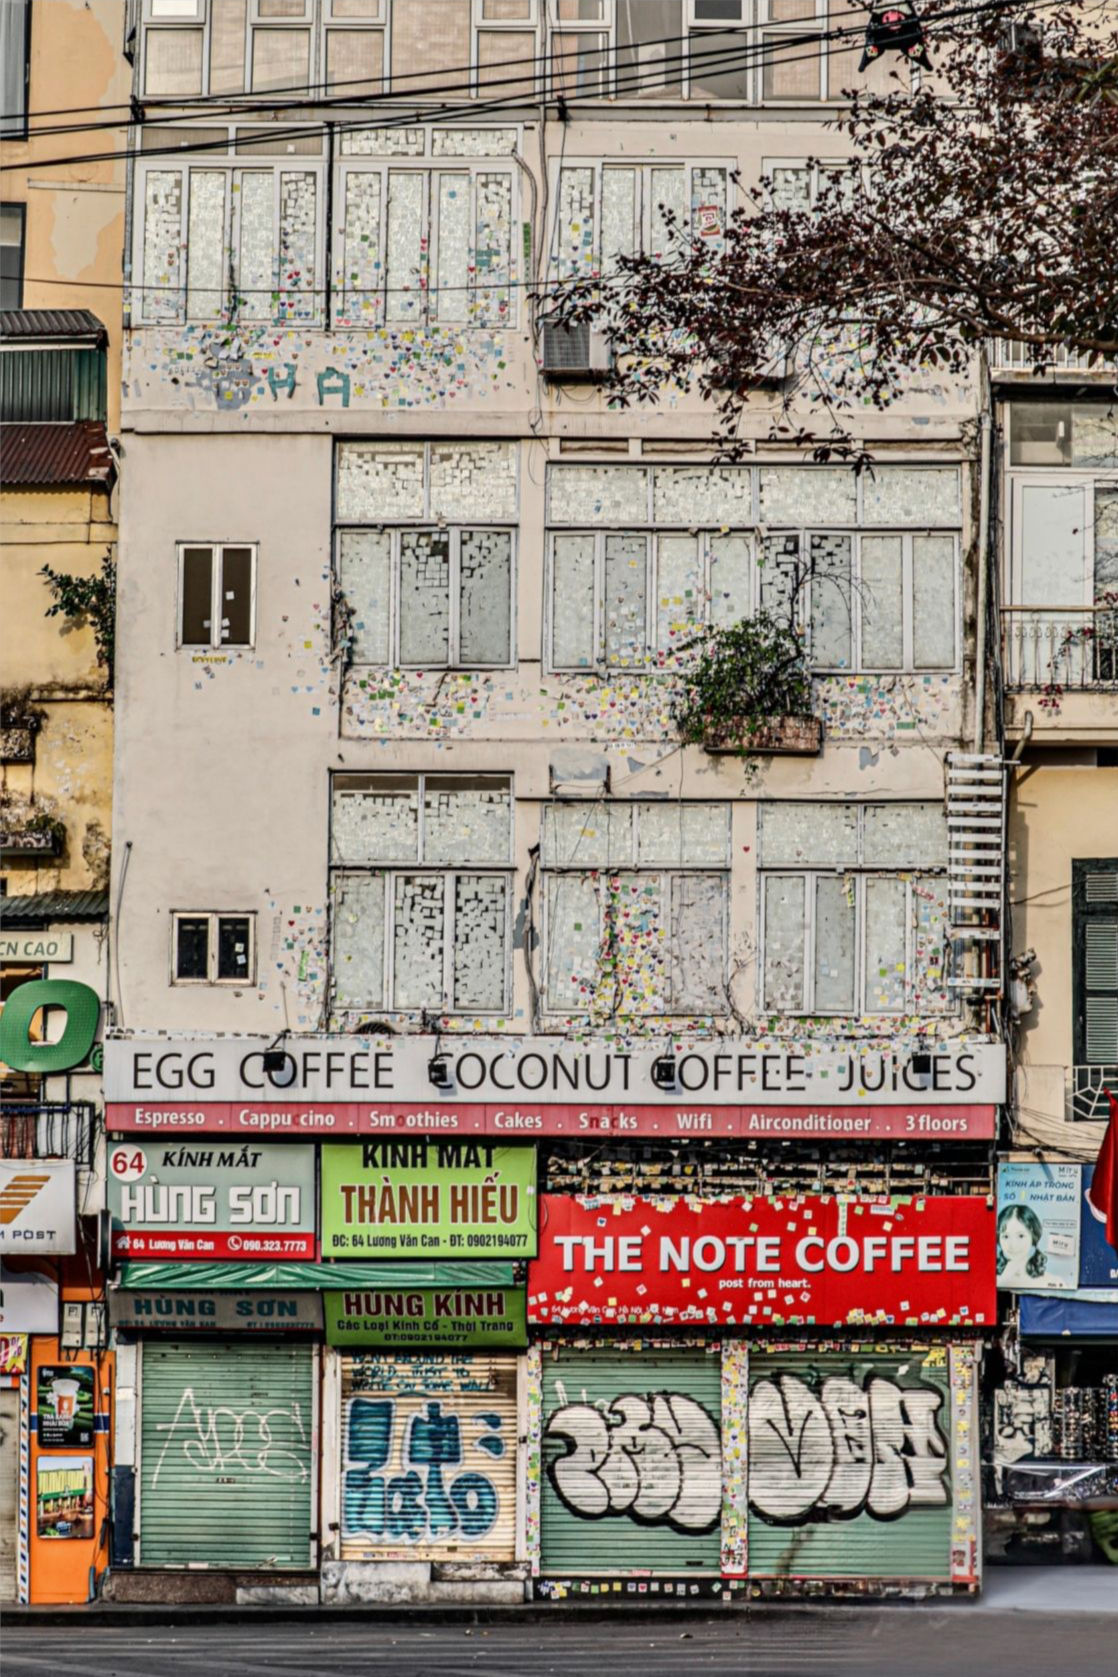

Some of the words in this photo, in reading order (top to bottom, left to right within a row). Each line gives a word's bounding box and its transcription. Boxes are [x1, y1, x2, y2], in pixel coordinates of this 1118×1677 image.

[24, 942, 58, 956] CAO
[133, 1052, 215, 1089] EGG
[239, 1052, 394, 1089] COFFEE
[430, 1052, 632, 1091] COCONUT
[135, 1107, 205, 1128] Espresso
[370, 1110, 458, 1129] Smoothies
[494, 1111, 543, 1129] Cakes
[579, 1112, 638, 1130] Snacks
[677, 1112, 712, 1130] Wifi
[749, 1113, 871, 1132] Airconditioner
[112, 1151, 145, 1174] 64
[162, 1147, 213, 1168] KÍNH
[217, 1145, 262, 1168] MẮT
[121, 1175, 217, 1224] HÙNG
[340, 1176, 440, 1224] THÀNH
[450, 1172, 519, 1224] HIẾU
[13, 1230, 56, 1240] POST
[133, 1239, 145, 1250] 64
[352, 1234, 364, 1247] 64
[421, 1234, 440, 1247] Can
[553, 1236, 644, 1273] THE
[659, 1235, 781, 1273] NOTE
[795, 1235, 970, 1273] COFFEE
[719, 1278, 743, 1290] post
[748, 1278, 774, 1288] from
[778, 1278, 811, 1288] heart.
[134, 1295, 216, 1316] HÙNG
[434, 1290, 505, 1317] KÍNH
